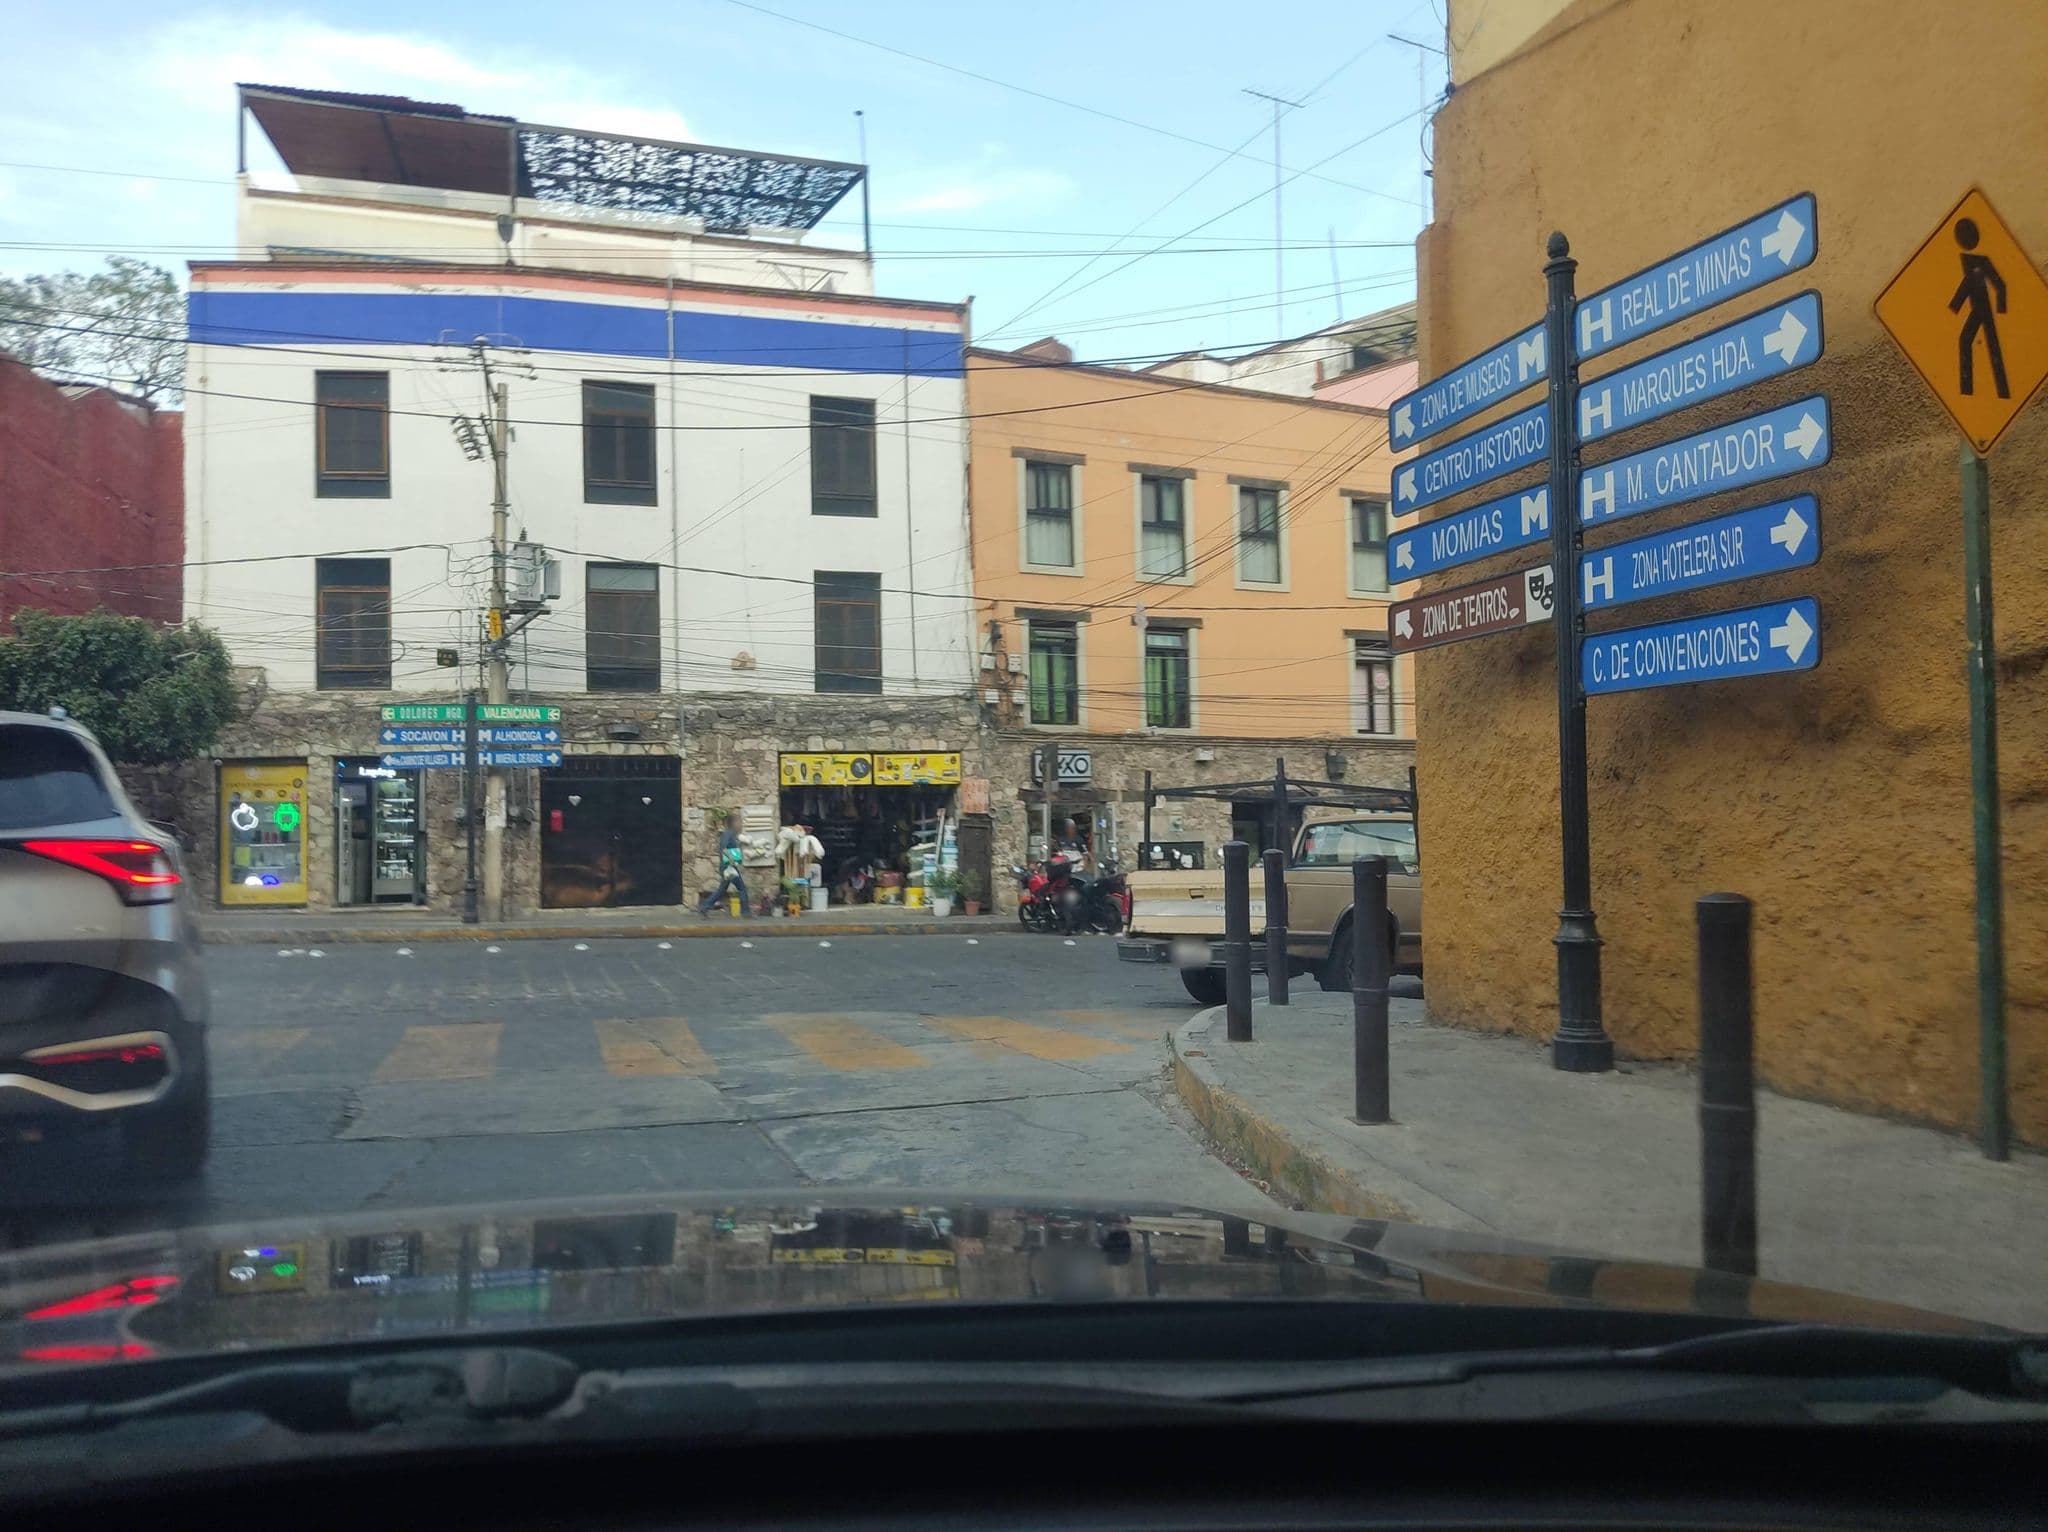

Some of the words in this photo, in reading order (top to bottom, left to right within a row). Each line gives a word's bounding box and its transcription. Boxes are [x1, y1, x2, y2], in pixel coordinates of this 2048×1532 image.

[1580, 298, 1613, 353] H
[1621, 280, 1664, 331] REAL
[1667, 265, 1691, 311] DE
[1695, 237, 1751, 298] MINAS
[1421, 388, 1449, 428] ZONA
[1450, 378, 1465, 414] DE
[1465, 353, 1511, 406] MUSEOS
[1517, 331, 1546, 383] M
[1581, 388, 1612, 437] H
[1623, 353, 1707, 416] MARQUES
[1711, 336, 1755, 384] HDA.
[1424, 448, 1472, 494] CENTRO
[1475, 416, 1545, 474] HISTORICO
[1583, 470, 1616, 520] H
[1627, 463, 1648, 504] M.
[1655, 424, 1776, 495] CANTADOR
[1432, 509, 1503, 562] MOMIAS
[1520, 489, 1549, 536] M
[1584, 556, 1614, 604] H
[1632, 548, 1661, 589] ZONA
[1662, 533, 1719, 582] HOTELERA
[1719, 526, 1745, 570] SUR
[1422, 602, 1448, 638] ZONA
[1449, 599, 1462, 631] DE
[1463, 586, 1508, 628] TEATROS
[1592, 647, 1606, 683] C.
[1611, 642, 1630, 680] DE
[1634, 620, 1760, 677] CONVENCIONES
[399, 706, 439, 719] DOLORES
[400, 730, 448, 742] SOCAVON
[484, 707, 541, 719] VALENCIANA
[495, 730, 542, 742] ALHONDIGA
